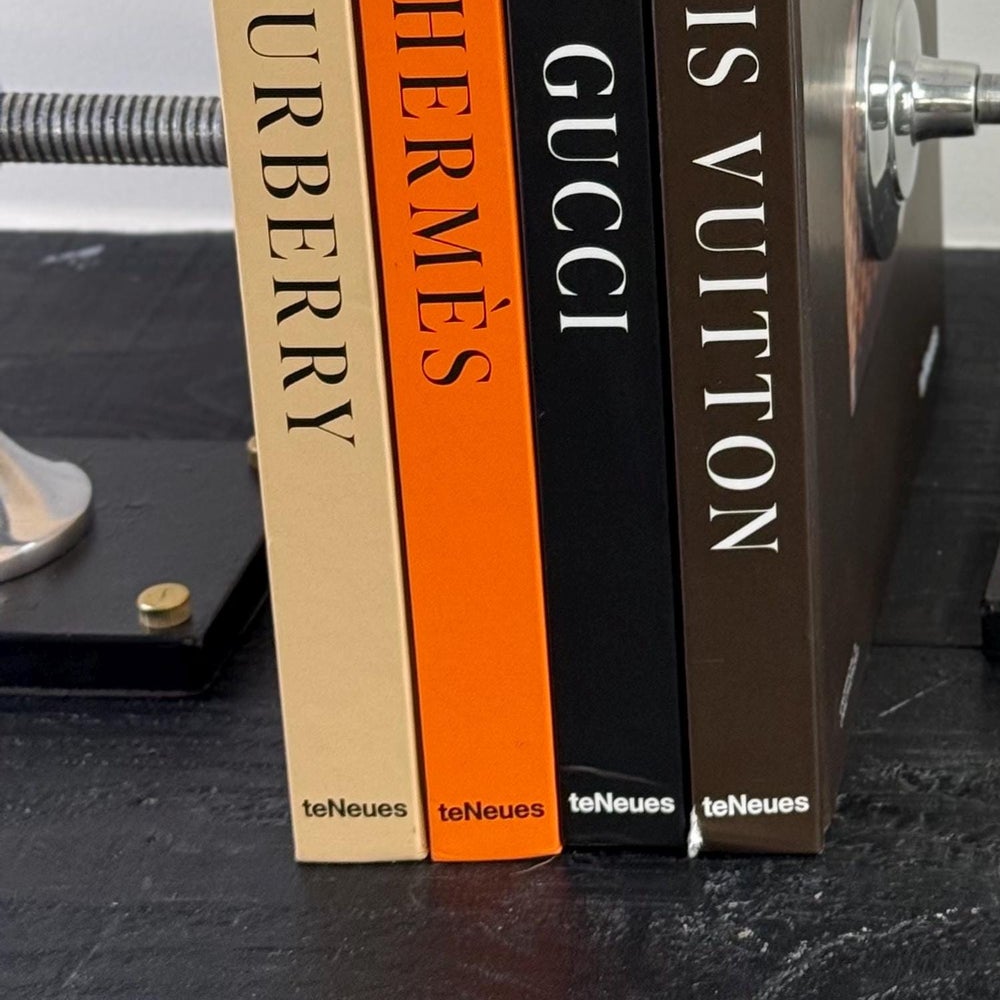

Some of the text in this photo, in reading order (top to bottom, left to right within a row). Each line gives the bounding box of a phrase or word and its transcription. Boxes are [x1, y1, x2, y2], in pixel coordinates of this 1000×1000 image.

[543, 44, 628, 332] GUCCI
[693, 132, 778, 552] VUITTON
[302, 798, 408, 818] teNeues
[437, 801, 545, 822] teNeues
[569, 792, 675, 813] teNeues
[702, 794, 809, 817] teNeues
